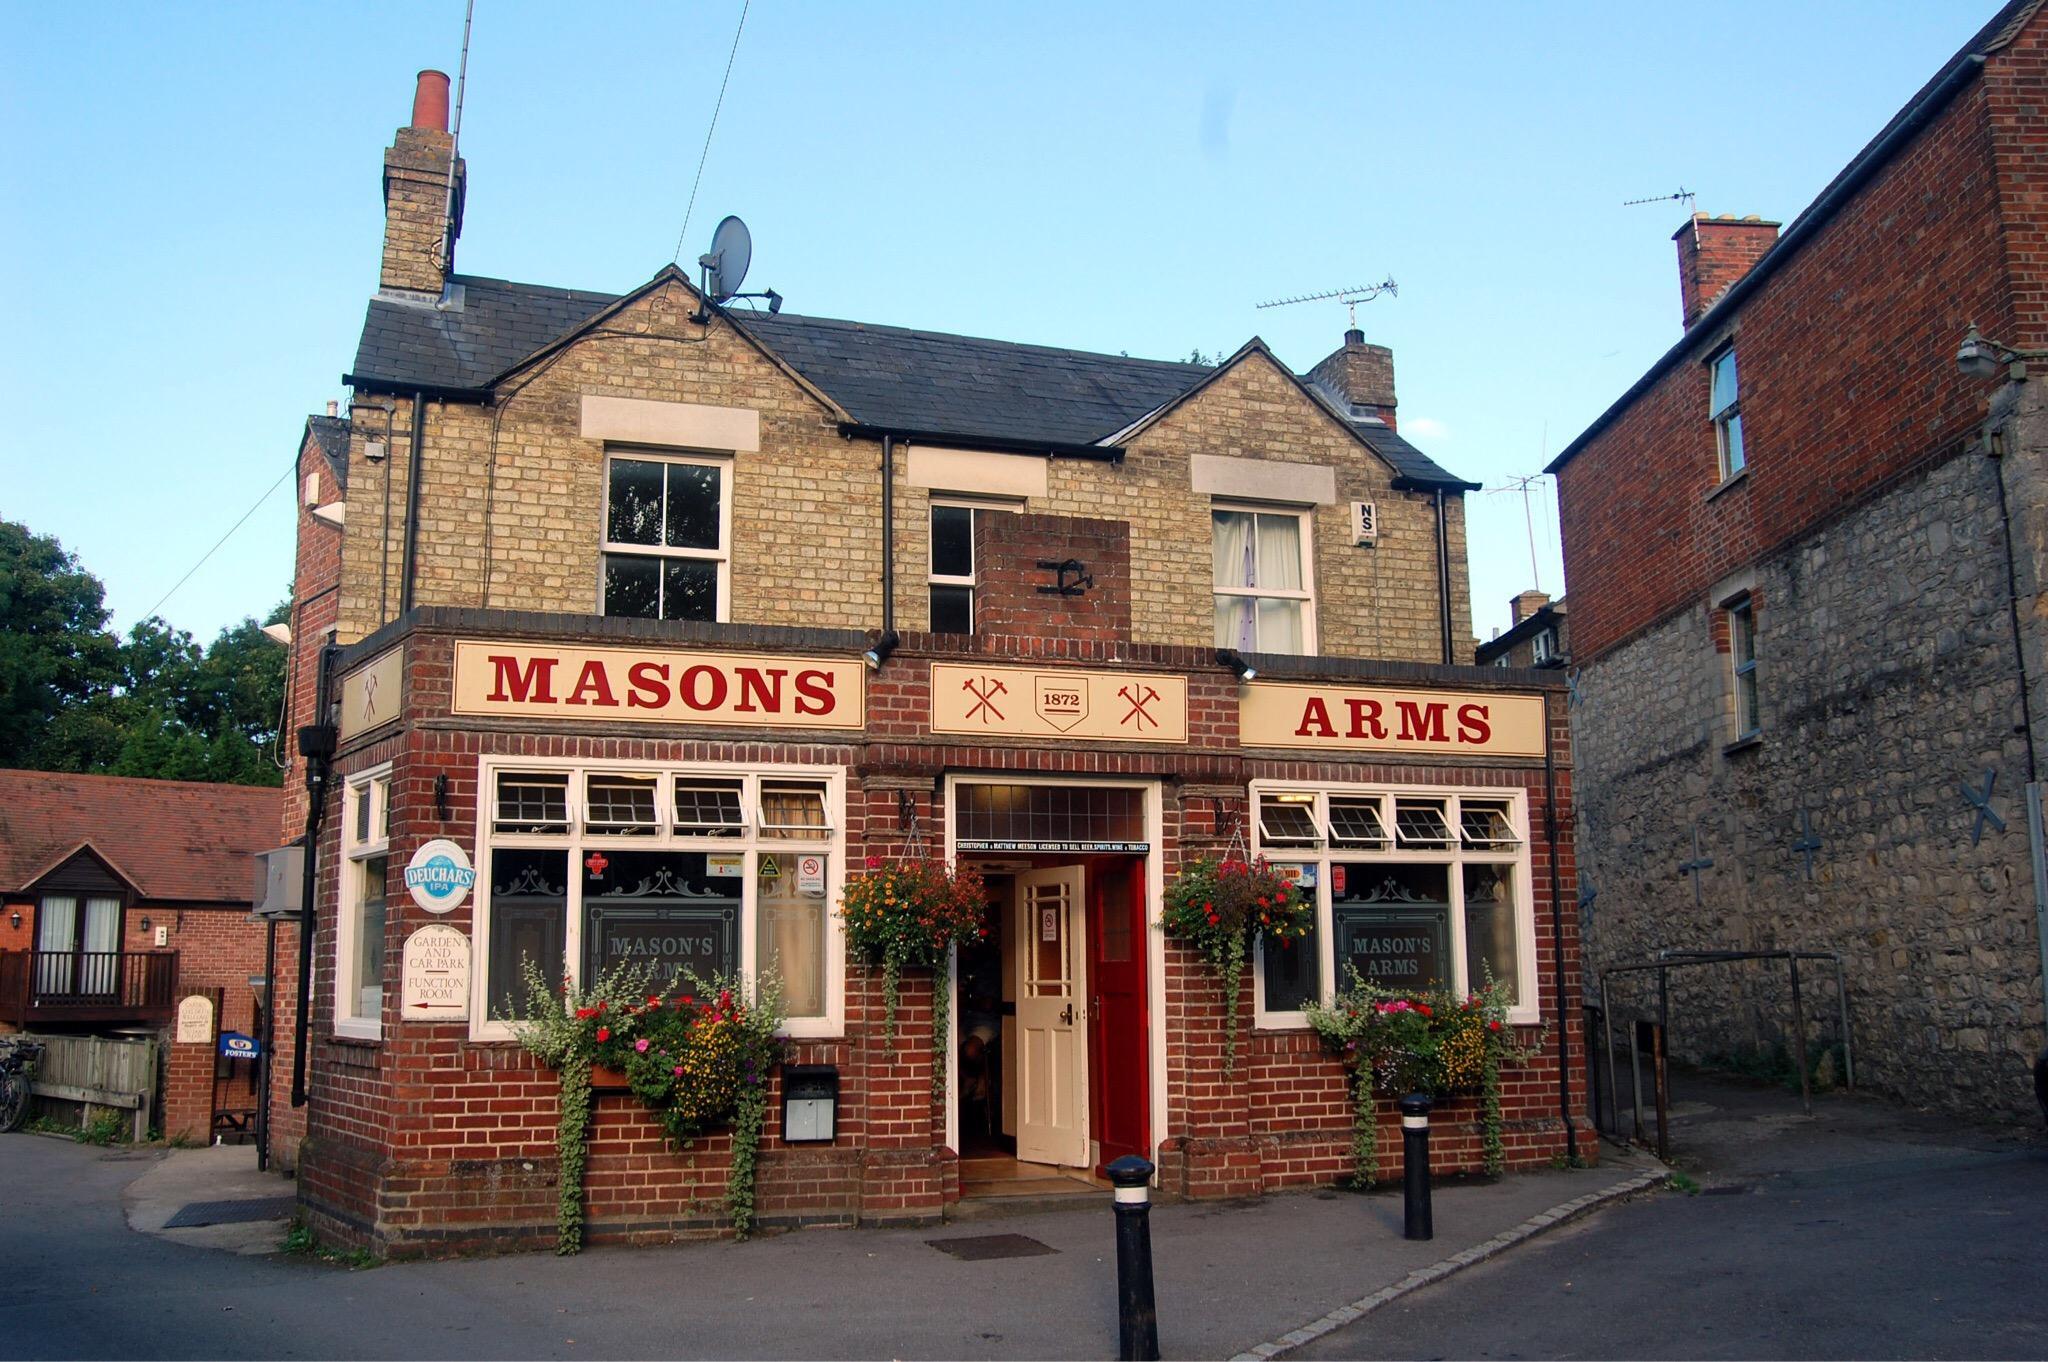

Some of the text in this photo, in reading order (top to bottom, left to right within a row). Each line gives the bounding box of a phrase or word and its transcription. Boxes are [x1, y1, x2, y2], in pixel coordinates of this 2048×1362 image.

[486, 655, 836, 715] MASONS
[1043, 693, 1080, 706] 1872
[1295, 697, 1491, 744] ARMS
[408, 867, 472, 885] DEUCHARS
[430, 882, 449, 891] IPA
[413, 937, 461, 947] GARDEN
[610, 937, 713, 955] MASON'S
[1353, 937, 1431, 954] MASON'S
[424, 948, 451, 957] AND
[409, 958, 465, 969] CAR PARK
[1368, 959, 1419, 975] ARMS
[408, 978, 464, 988] FUNCTION
[419, 989, 453, 999] ROOM
